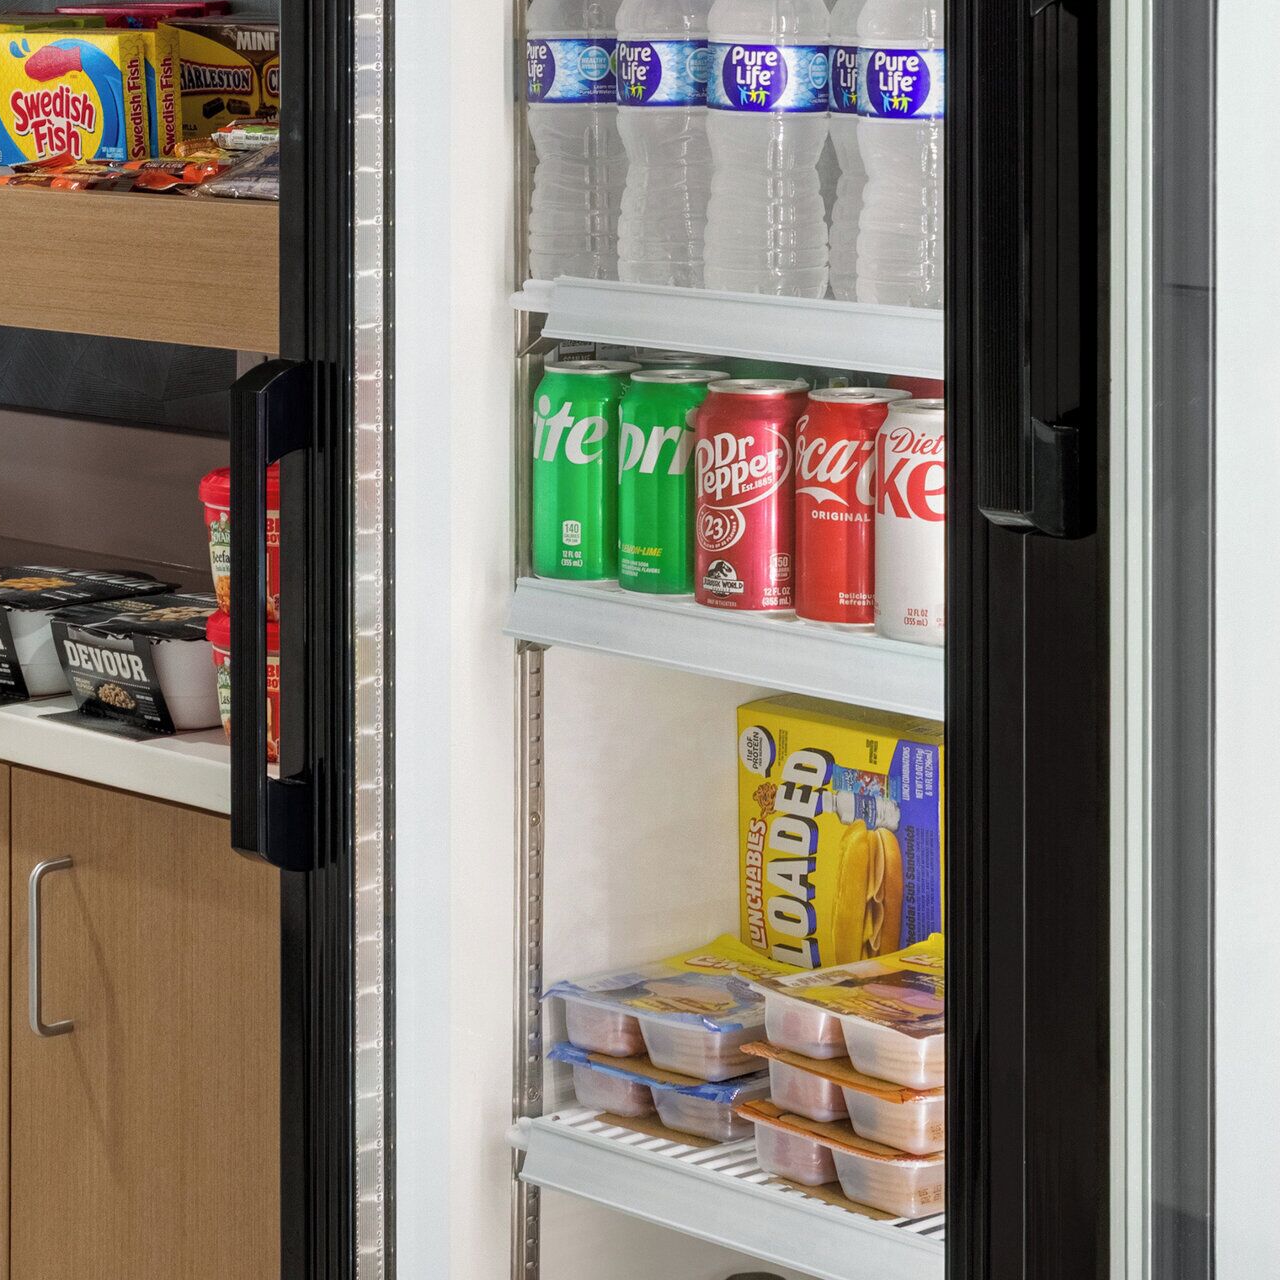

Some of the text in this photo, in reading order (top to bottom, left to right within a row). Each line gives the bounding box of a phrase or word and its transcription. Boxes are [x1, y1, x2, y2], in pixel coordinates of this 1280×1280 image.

[236, 31, 276, 51] MINI
[620, 42, 652, 62] Pure
[732, 45, 778, 66] Pure
[874, 53, 920, 73] Pure
[622, 61, 647, 84] Life
[736, 65, 771, 90] Life
[879, 71, 913, 96] Life
[11, 85, 95, 132] Swedish
[128, 58, 146, 159] Swedish Fish
[160, 57, 175, 156] Swedish Fish
[31, 119, 80, 158] Fish
[714, 432, 755, 468] Dr
[889, 427, 944, 455] Diet
[695, 438, 784, 501] Pepper
[564, 523, 579, 534] 140
[705, 515, 724, 540] 23
[811, 509, 871, 522] ORIGINAL
[722, 580, 744, 590] WORLD
[63, 639, 149, 683] DEVOUR
[901, 746, 911, 801] LUNCH COMBINATIONS
[767, 747, 833, 970] LOADED
[905, 825, 916, 903] Sub Sandwich
[745, 816, 768, 950] LUNCHABLES
